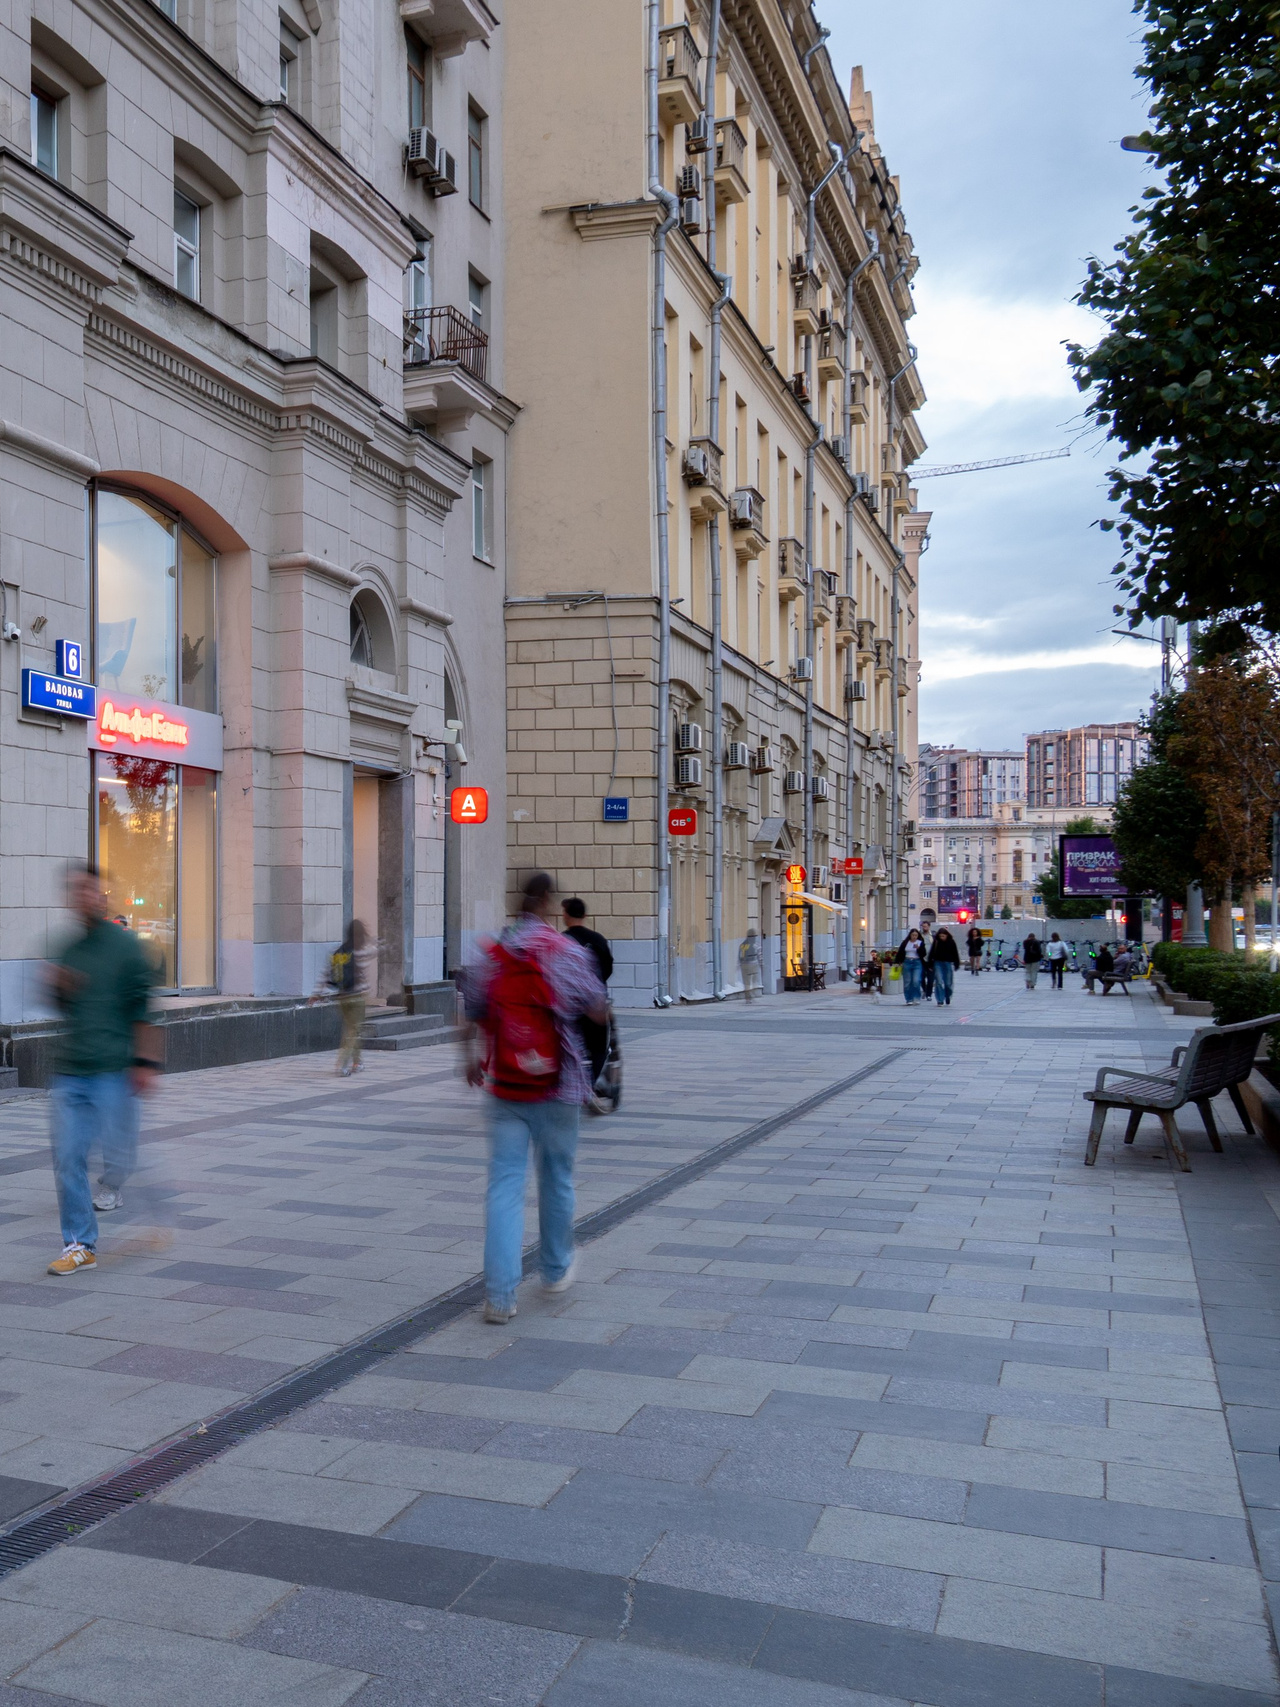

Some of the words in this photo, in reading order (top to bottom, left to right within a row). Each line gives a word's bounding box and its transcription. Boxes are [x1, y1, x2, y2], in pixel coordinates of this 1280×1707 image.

[68, 647, 77, 672] 6
[45, 680, 83, 700] ВАЛОВАЯ
[56, 698, 73, 710] УЛИЦА
[1066, 851, 1116, 861] ПРИЗРАК
